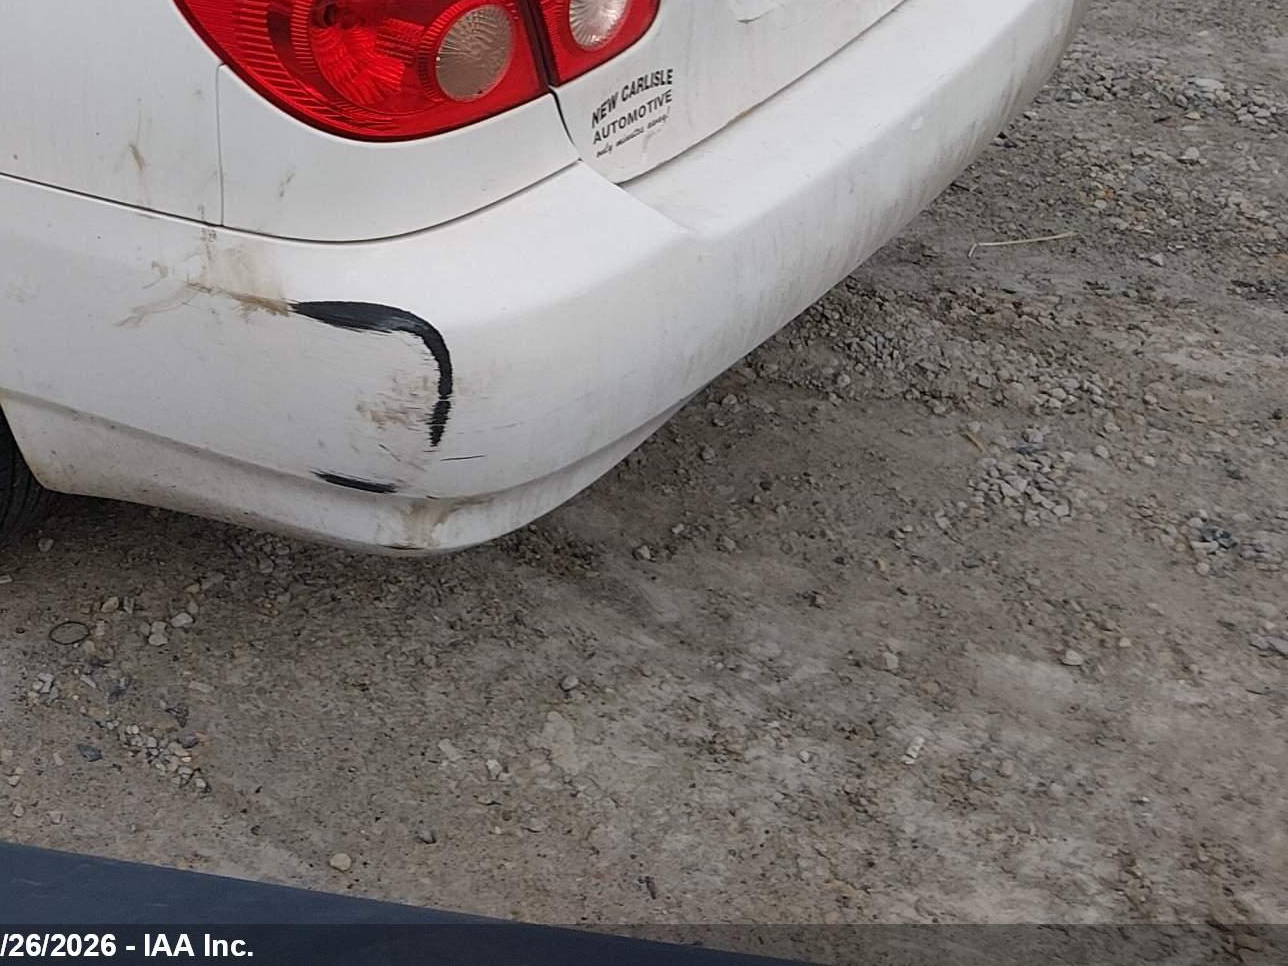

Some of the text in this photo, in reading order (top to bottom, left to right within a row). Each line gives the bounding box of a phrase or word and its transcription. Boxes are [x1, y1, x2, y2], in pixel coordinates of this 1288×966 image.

[592, 68, 674, 129] NEW CARLISLE
[593, 89, 673, 144] AUTOMOTIVE
